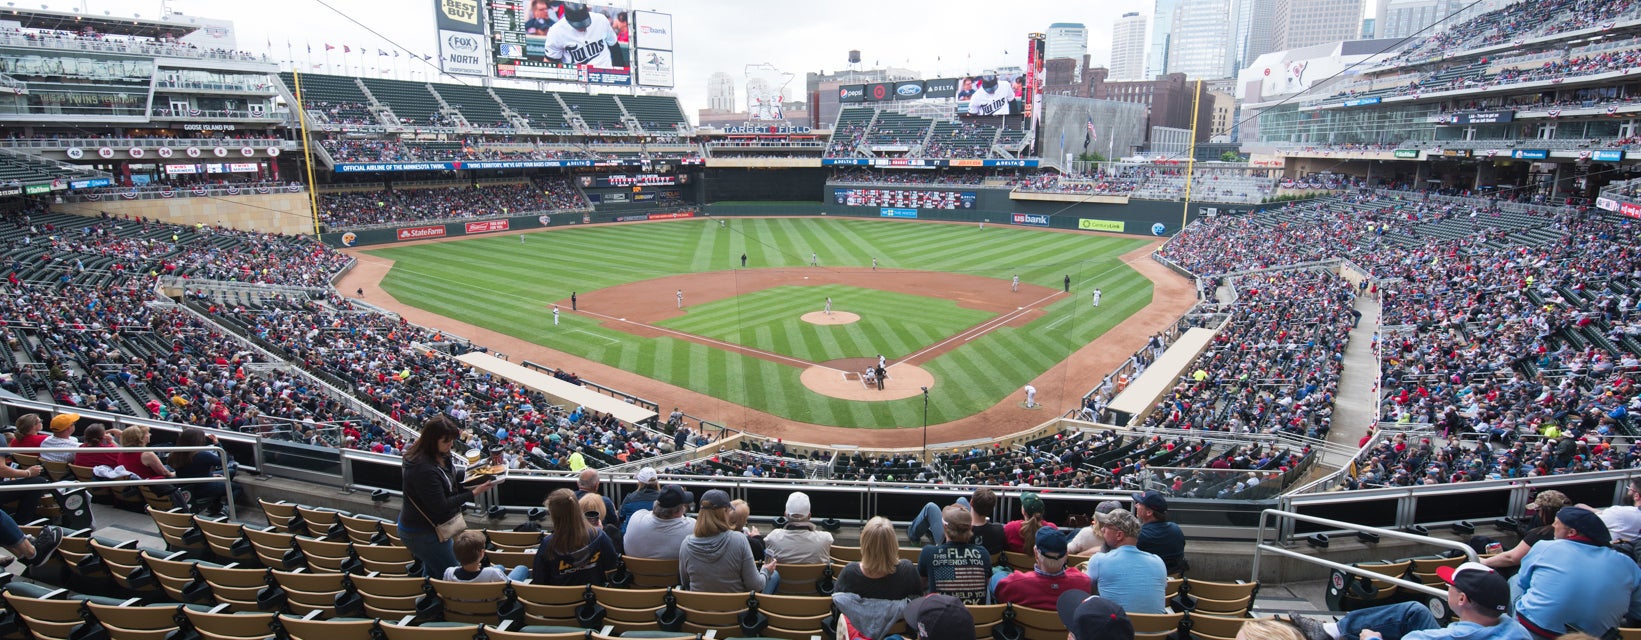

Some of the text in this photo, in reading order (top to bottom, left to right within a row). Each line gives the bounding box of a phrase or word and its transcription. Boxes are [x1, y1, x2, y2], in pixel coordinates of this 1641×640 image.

[446, 0, 476, 12] BEST
[448, 8, 474, 20] BUY
[454, 36, 472, 46] FOX
[565, 38, 605, 64] Twins
[450, 54, 479, 64] NORTH
[68, 95, 98, 104] TWINS
[980, 98, 1006, 115] Twins
[948, 548, 981, 559] FLAG
